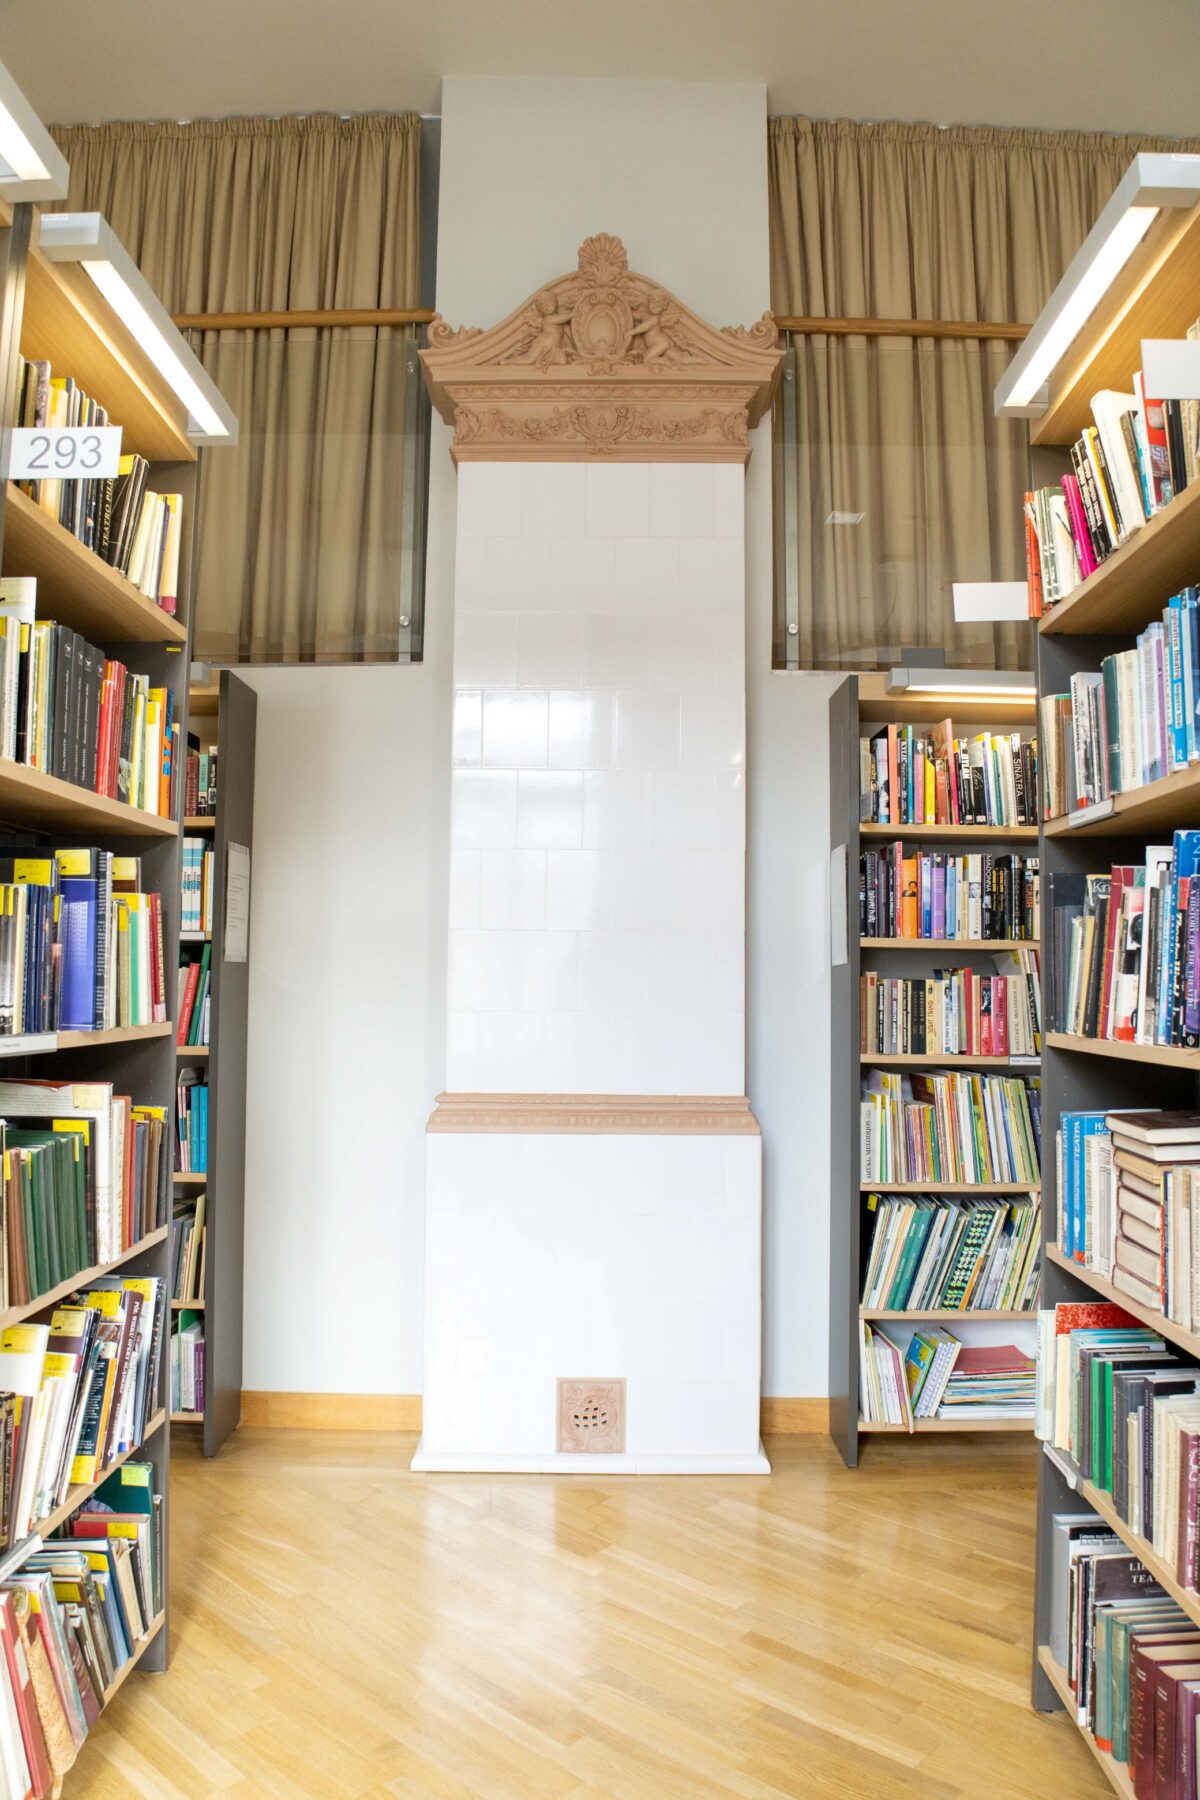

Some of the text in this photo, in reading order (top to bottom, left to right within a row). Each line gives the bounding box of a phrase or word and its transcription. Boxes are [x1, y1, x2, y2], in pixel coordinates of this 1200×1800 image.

[27, 434, 103, 470] 293
[102, 504, 111, 547] TEATRO
[1173, 649, 1181, 679] theatre
[961, 754, 970, 779] DYLAN
[1013, 758, 1023, 797] SINATRA
[985, 854, 993, 892] MADONNA
[1189, 935, 1195, 944] OF
[1073, 1120, 1081, 1158] ТЕАТРА
[128, 1315, 138, 1338] WIEKU
